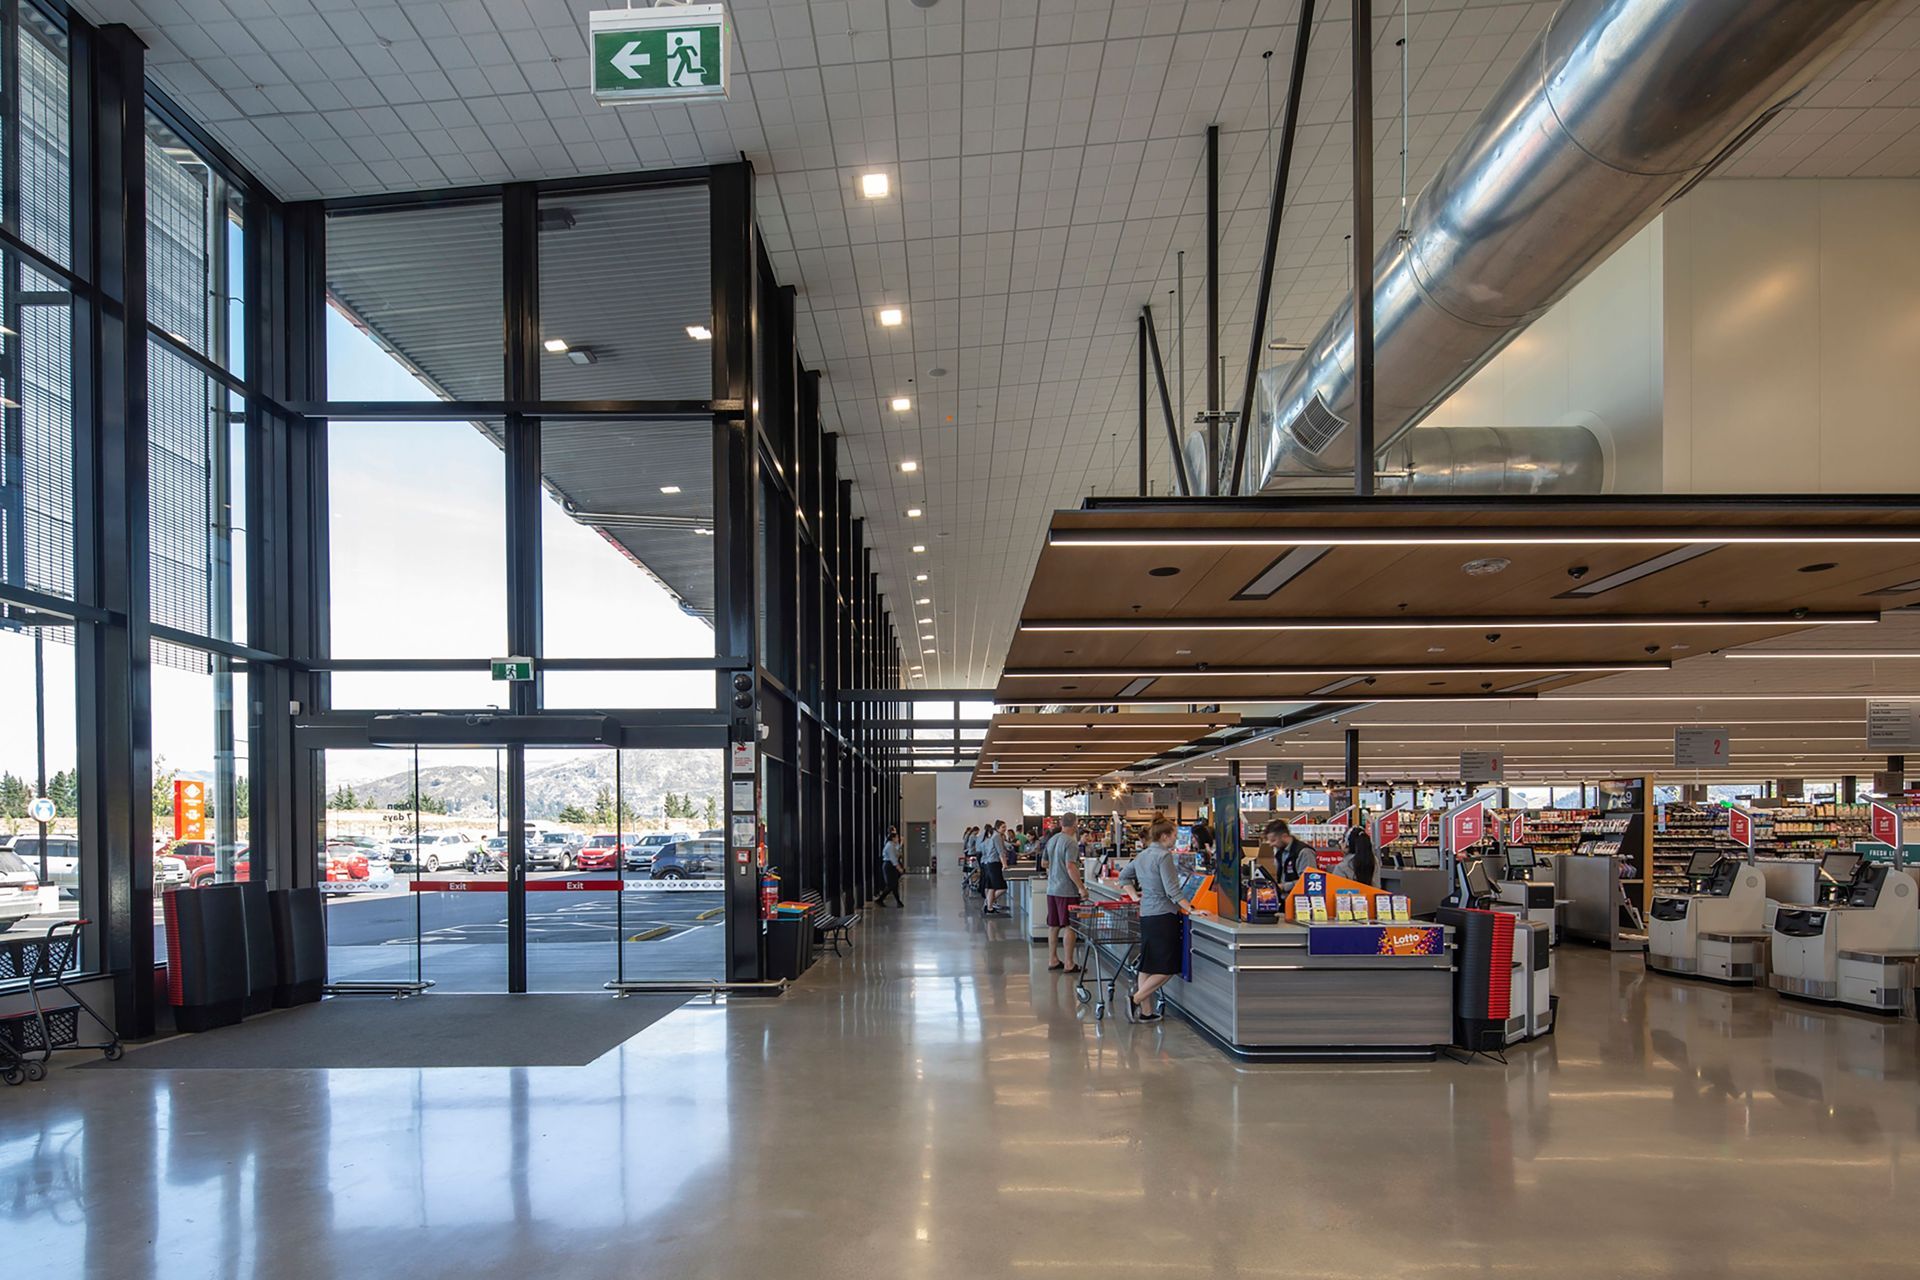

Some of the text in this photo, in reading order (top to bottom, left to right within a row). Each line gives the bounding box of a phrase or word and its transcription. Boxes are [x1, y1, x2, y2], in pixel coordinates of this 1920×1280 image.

[1713, 739, 1721, 755] 2
[449, 882, 466, 890] Exit
[566, 881, 584, 890] Exit
[1308, 881, 1322, 891] 25
[1393, 934, 1420, 945] Lotto
